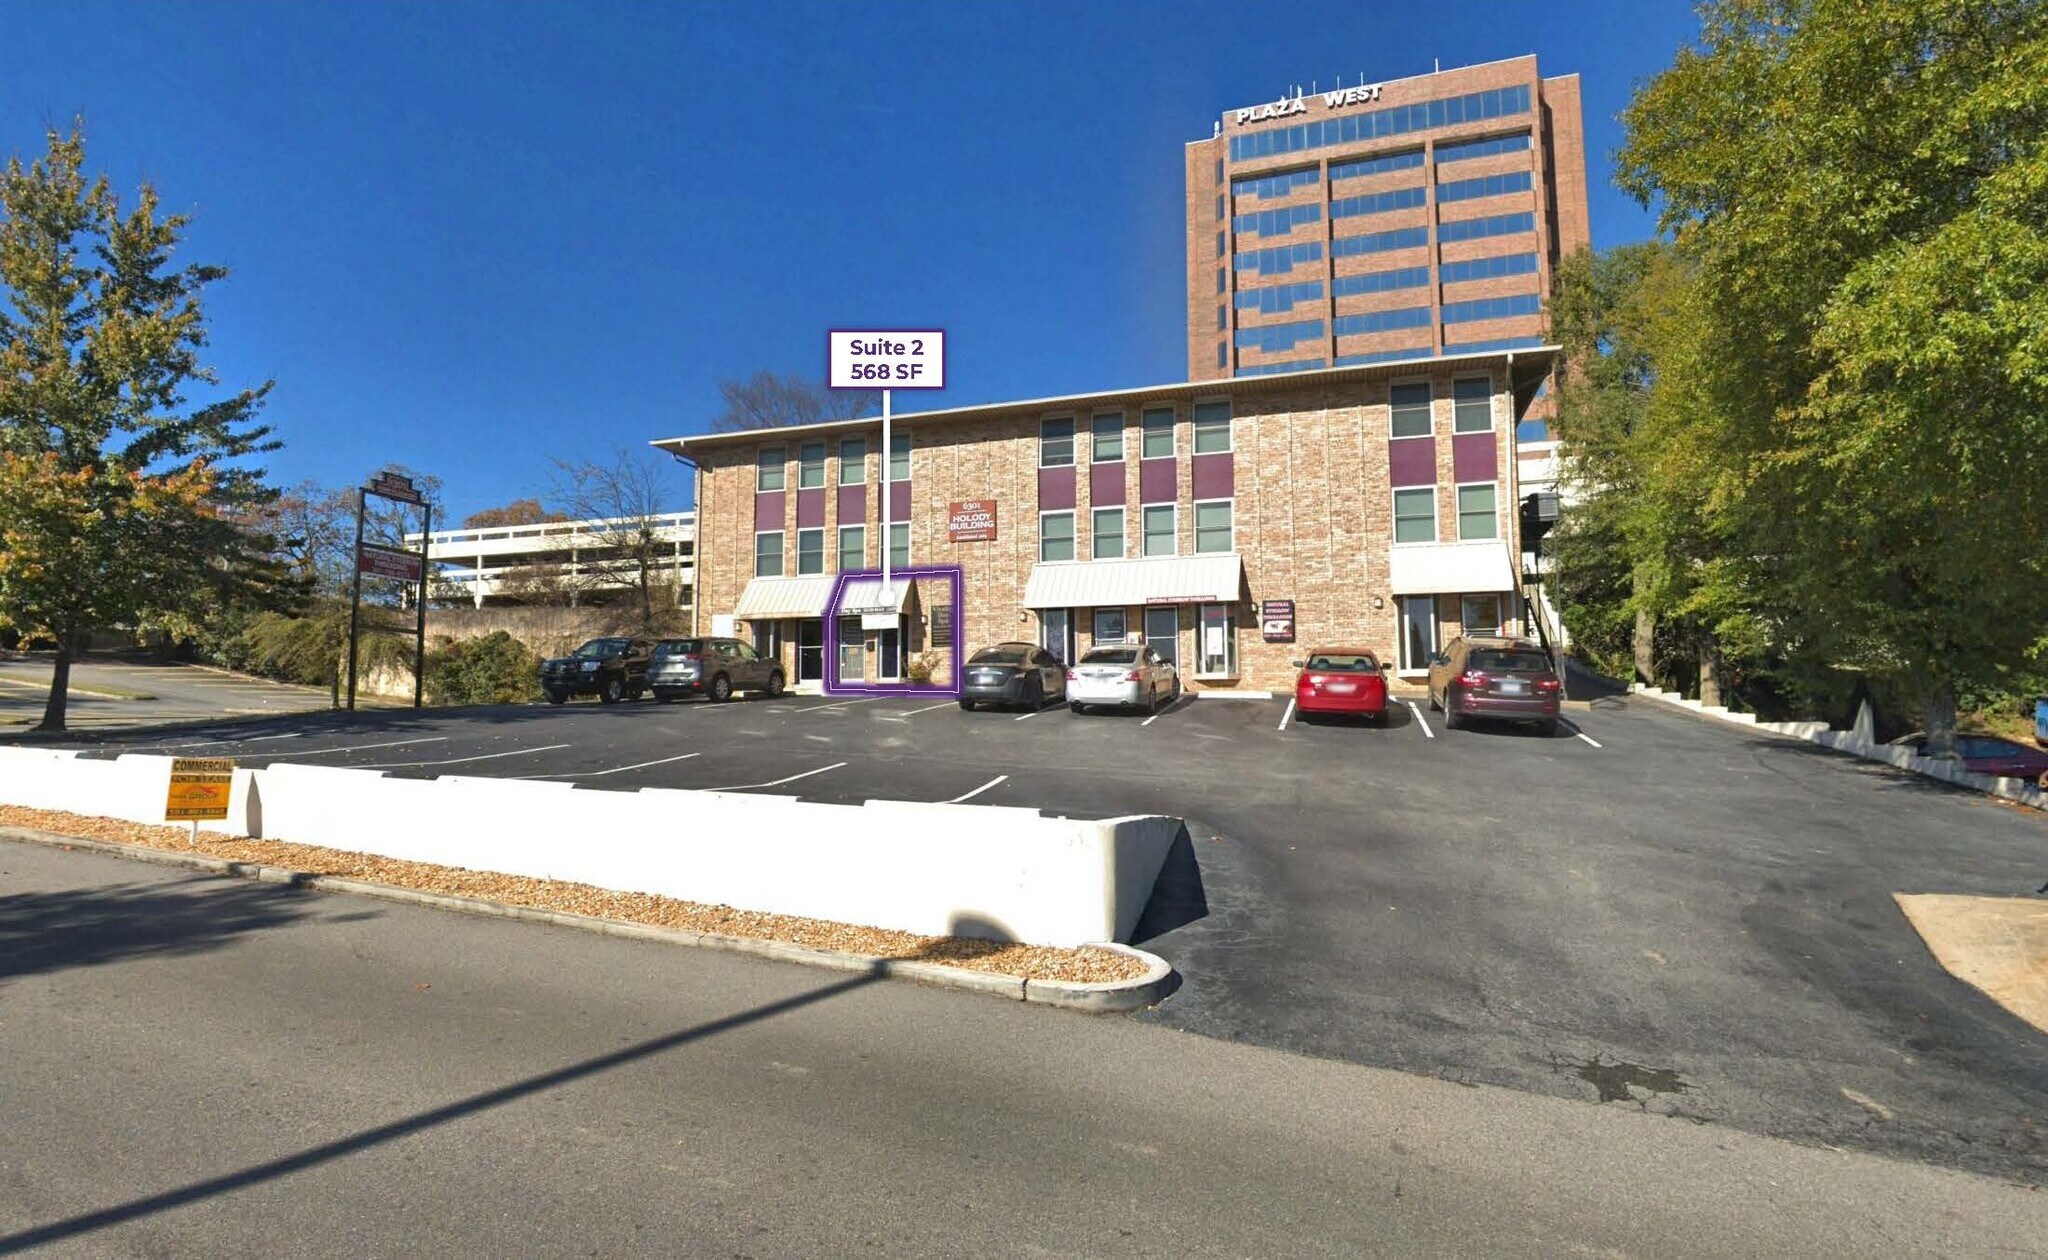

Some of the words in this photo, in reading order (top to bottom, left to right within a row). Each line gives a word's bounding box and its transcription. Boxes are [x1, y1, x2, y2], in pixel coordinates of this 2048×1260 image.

[1237, 100, 1306, 124] PLAZA
[1323, 84, 1382, 107] WEST
[952, 513, 991, 522] HOLODY
[950, 521, 994, 530] BUILDING
[174, 760, 231, 772] COMMERCIAL
